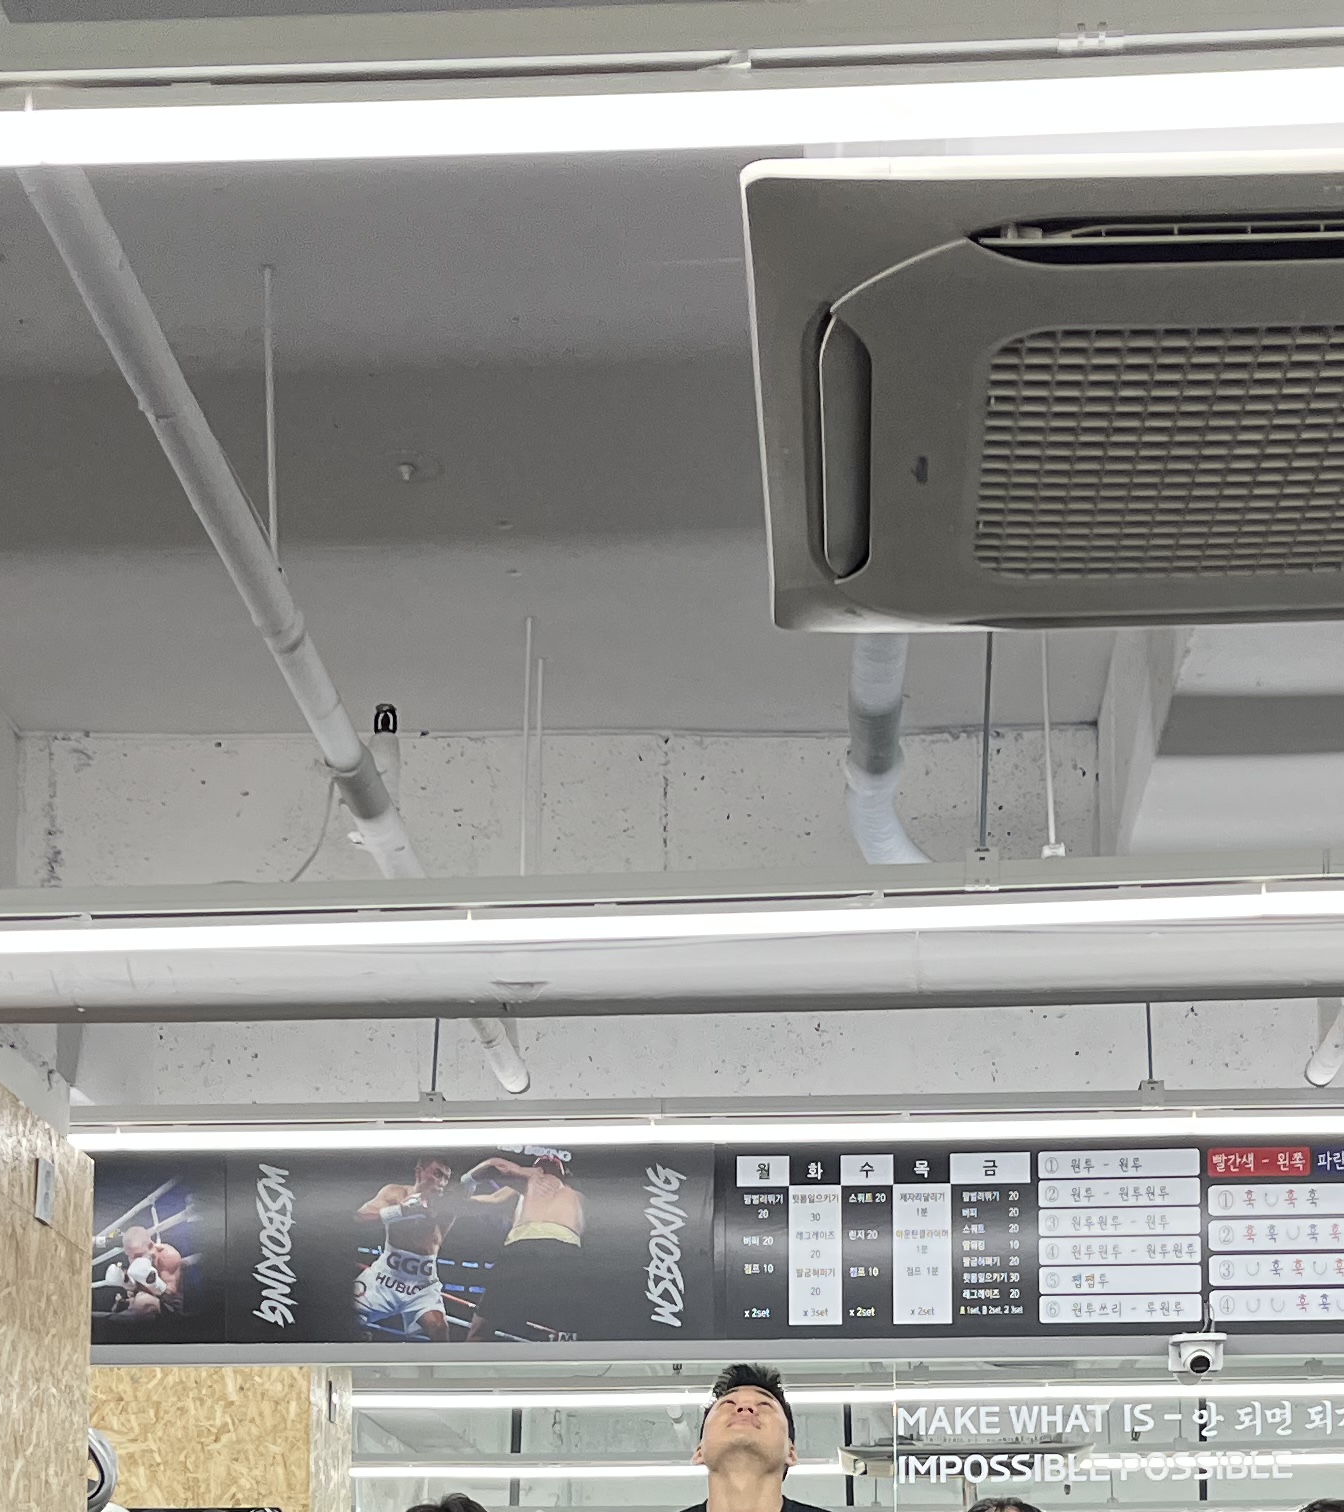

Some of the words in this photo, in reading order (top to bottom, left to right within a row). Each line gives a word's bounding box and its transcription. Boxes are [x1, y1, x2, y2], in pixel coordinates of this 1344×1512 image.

[1213, 1153, 1255, 1172] 빨간색
[1277, 1152, 1306, 1171] 왼쪽
[756, 1162, 770, 1180] 월
[807, 1162, 823, 1180] 화
[860, 1162, 875, 1179] 수
[914, 1160, 930, 1178] 목
[983, 1160, 998, 1176] 금
[875, 1193, 887, 1203] 20
[1009, 1191, 1019, 1200] 20
[758, 1209, 768, 1218] 20
[810, 1213, 820, 1221] 30
[1009, 1208, 1019, 1217] 20
[1009, 1224, 1019, 1233] 20
[867, 1230, 878, 1239] 20
[763, 1236, 773, 1245] 20
[1010, 1240, 1019, 1249] 10
[251, 1163, 298, 1328] WSBOXING
[645, 1164, 687, 1328] WSBOXING
[811, 1250, 820, 1258] 20
[386, 1251, 435, 1276] GGG
[1009, 1257, 1020, 1266] 20
[763, 1264, 773, 1273] 10
[869, 1267, 879, 1276] 10
[1010, 1273, 1020, 1282] 30
[811, 1287, 820, 1295] 20
[1010, 1289, 1020, 1298] 20
[752, 1308, 770, 1317] 2set
[811, 1308, 828, 1317] 3set
[857, 1307, 875, 1317] 2set
[918, 1306, 935, 1315] 2set
[897, 1406, 1000, 1435] MAKE
[1009, 1404, 1110, 1434] WHAT
[1123, 1403, 1155, 1433] IS
[1192, 1401, 1224, 1437] 안
[1235, 1401, 1293, 1436] 되면
[898, 1453, 1110, 1484] IMPOSSIBLE
[1119, 1451, 1293, 1481] POSSIBLE
